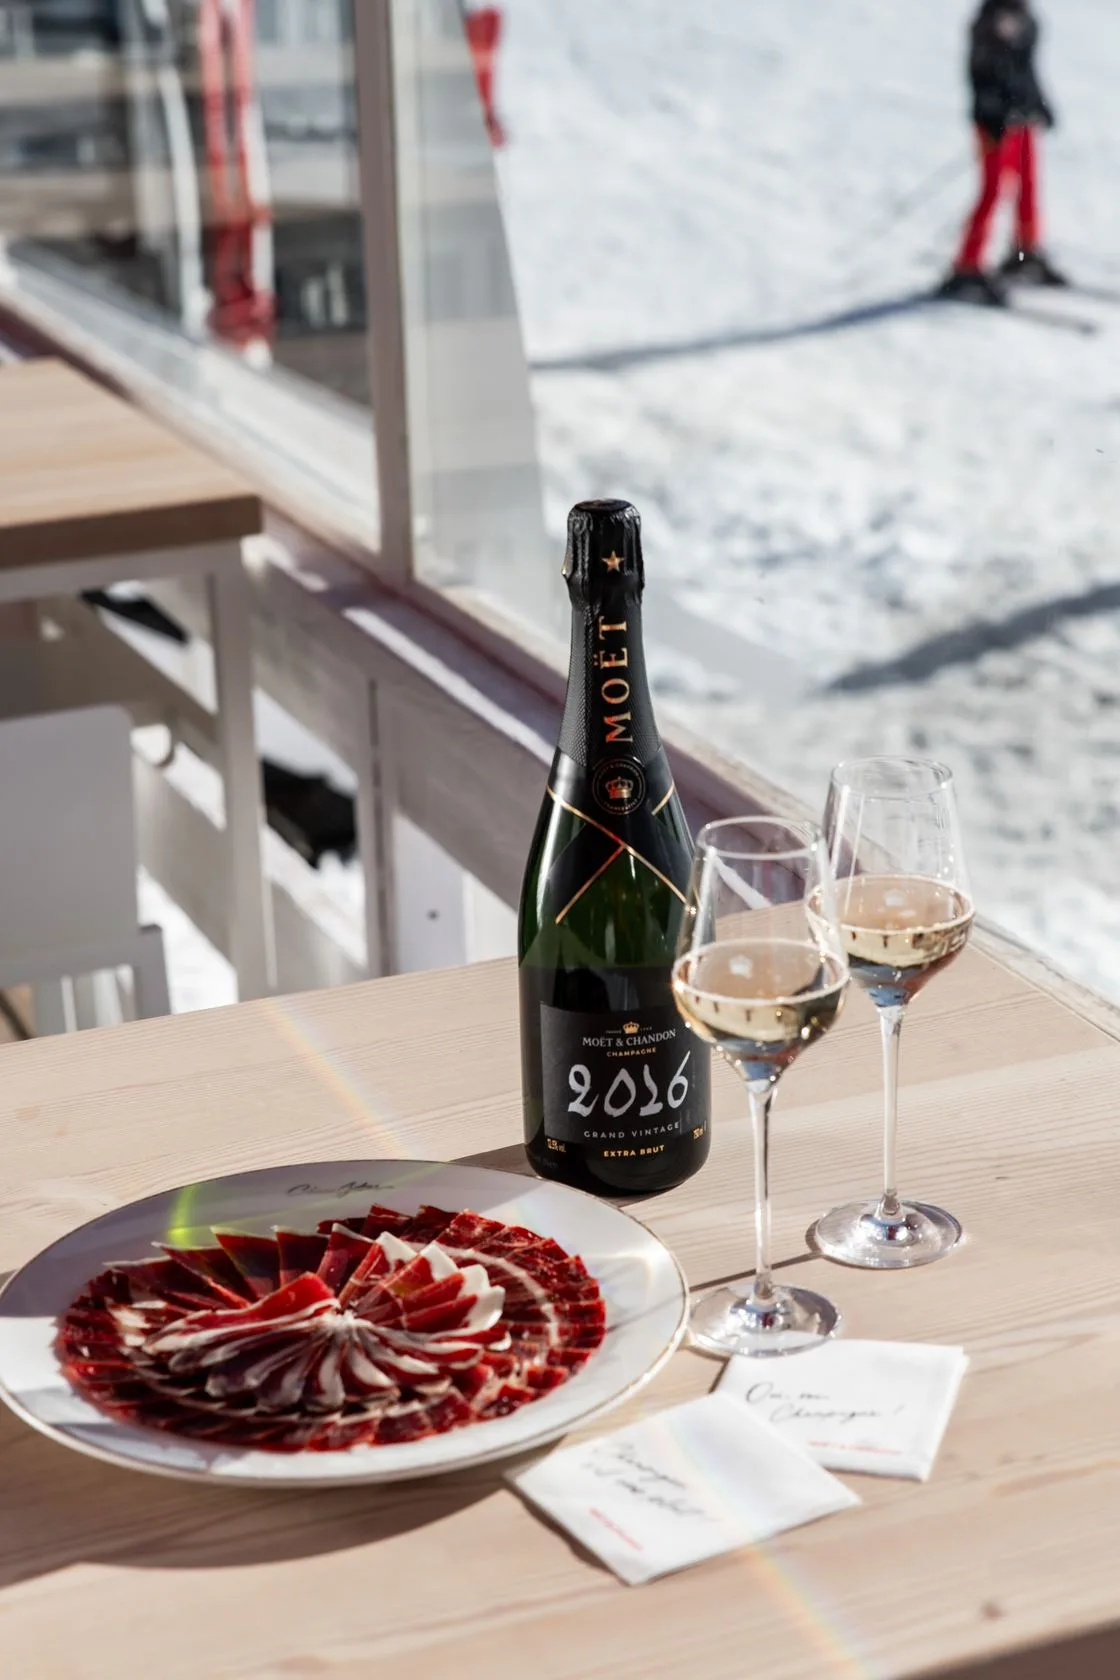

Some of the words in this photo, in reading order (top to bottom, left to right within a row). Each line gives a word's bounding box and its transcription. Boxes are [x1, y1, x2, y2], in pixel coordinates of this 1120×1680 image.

[593, 615, 634, 743] MOËT
[582, 1036, 613, 1047] MOËT
[615, 1038, 624, 1047] &
[626, 1028, 676, 1046] CHANDON
[606, 1047, 657, 1057] CHAMPAGNE
[568, 1050, 691, 1117] 2016
[583, 1130, 625, 1139] GRAND
[631, 1121, 680, 1137] VINTAGE
[603, 1149, 636, 1157] EXTRA
[640, 1144, 665, 1155] BRUT
